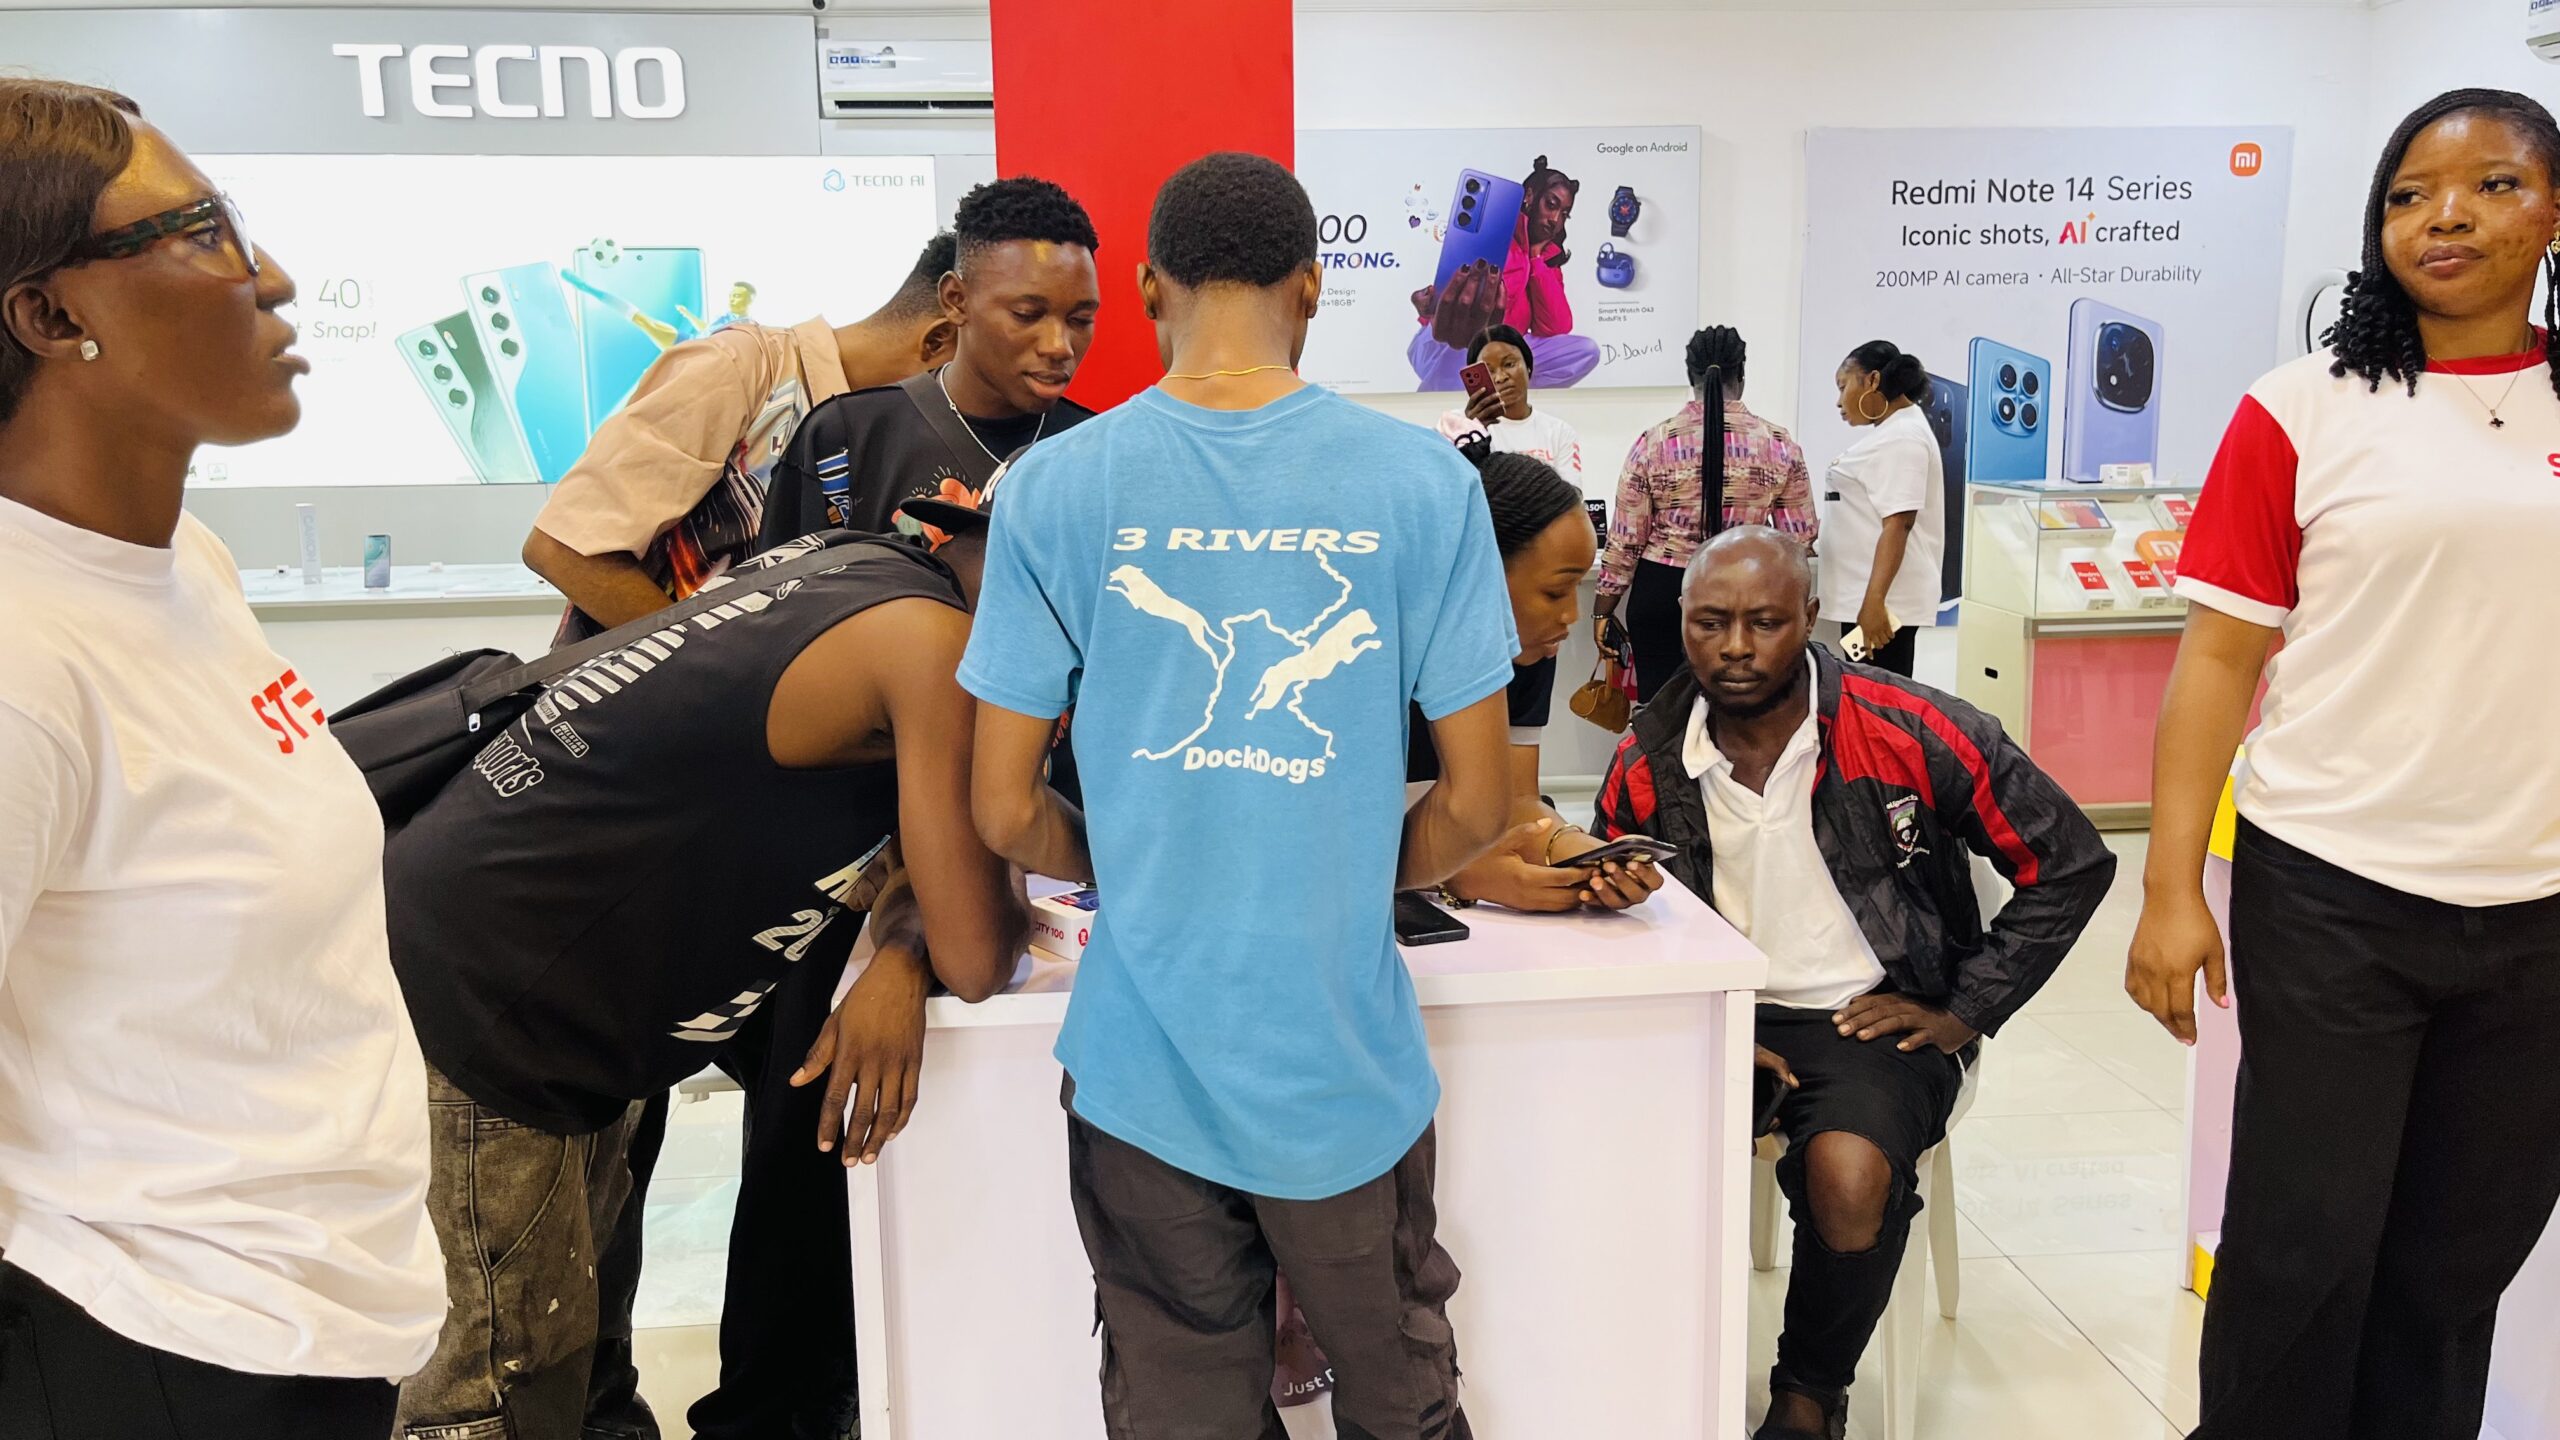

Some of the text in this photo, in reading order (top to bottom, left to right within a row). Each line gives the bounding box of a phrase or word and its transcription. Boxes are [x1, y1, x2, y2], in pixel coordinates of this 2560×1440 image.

[333, 43, 686, 119] TECNO
[1596, 141, 1688, 155] Google on Android
[853, 175, 925, 187] TECNO AI
[1891, 175, 2193, 205] Redmi Note 14 Series
[1902, 220, 2181, 248] Iconic shots, AI crafted
[1317, 252, 1401, 269] TRONG.
[1875, 265, 2202, 288] 200MP AI camera All-Star Durability
[318, 278, 361, 310] 40
[1327, 288, 1356, 297] Design
[313, 321, 377, 343] Snap!
[1112, 527, 1381, 554] 3 RIVERS
[1183, 744, 1327, 784] DockDogs
[1051, 927, 1065, 940] 100
[1283, 1375, 1325, 1396] Just
